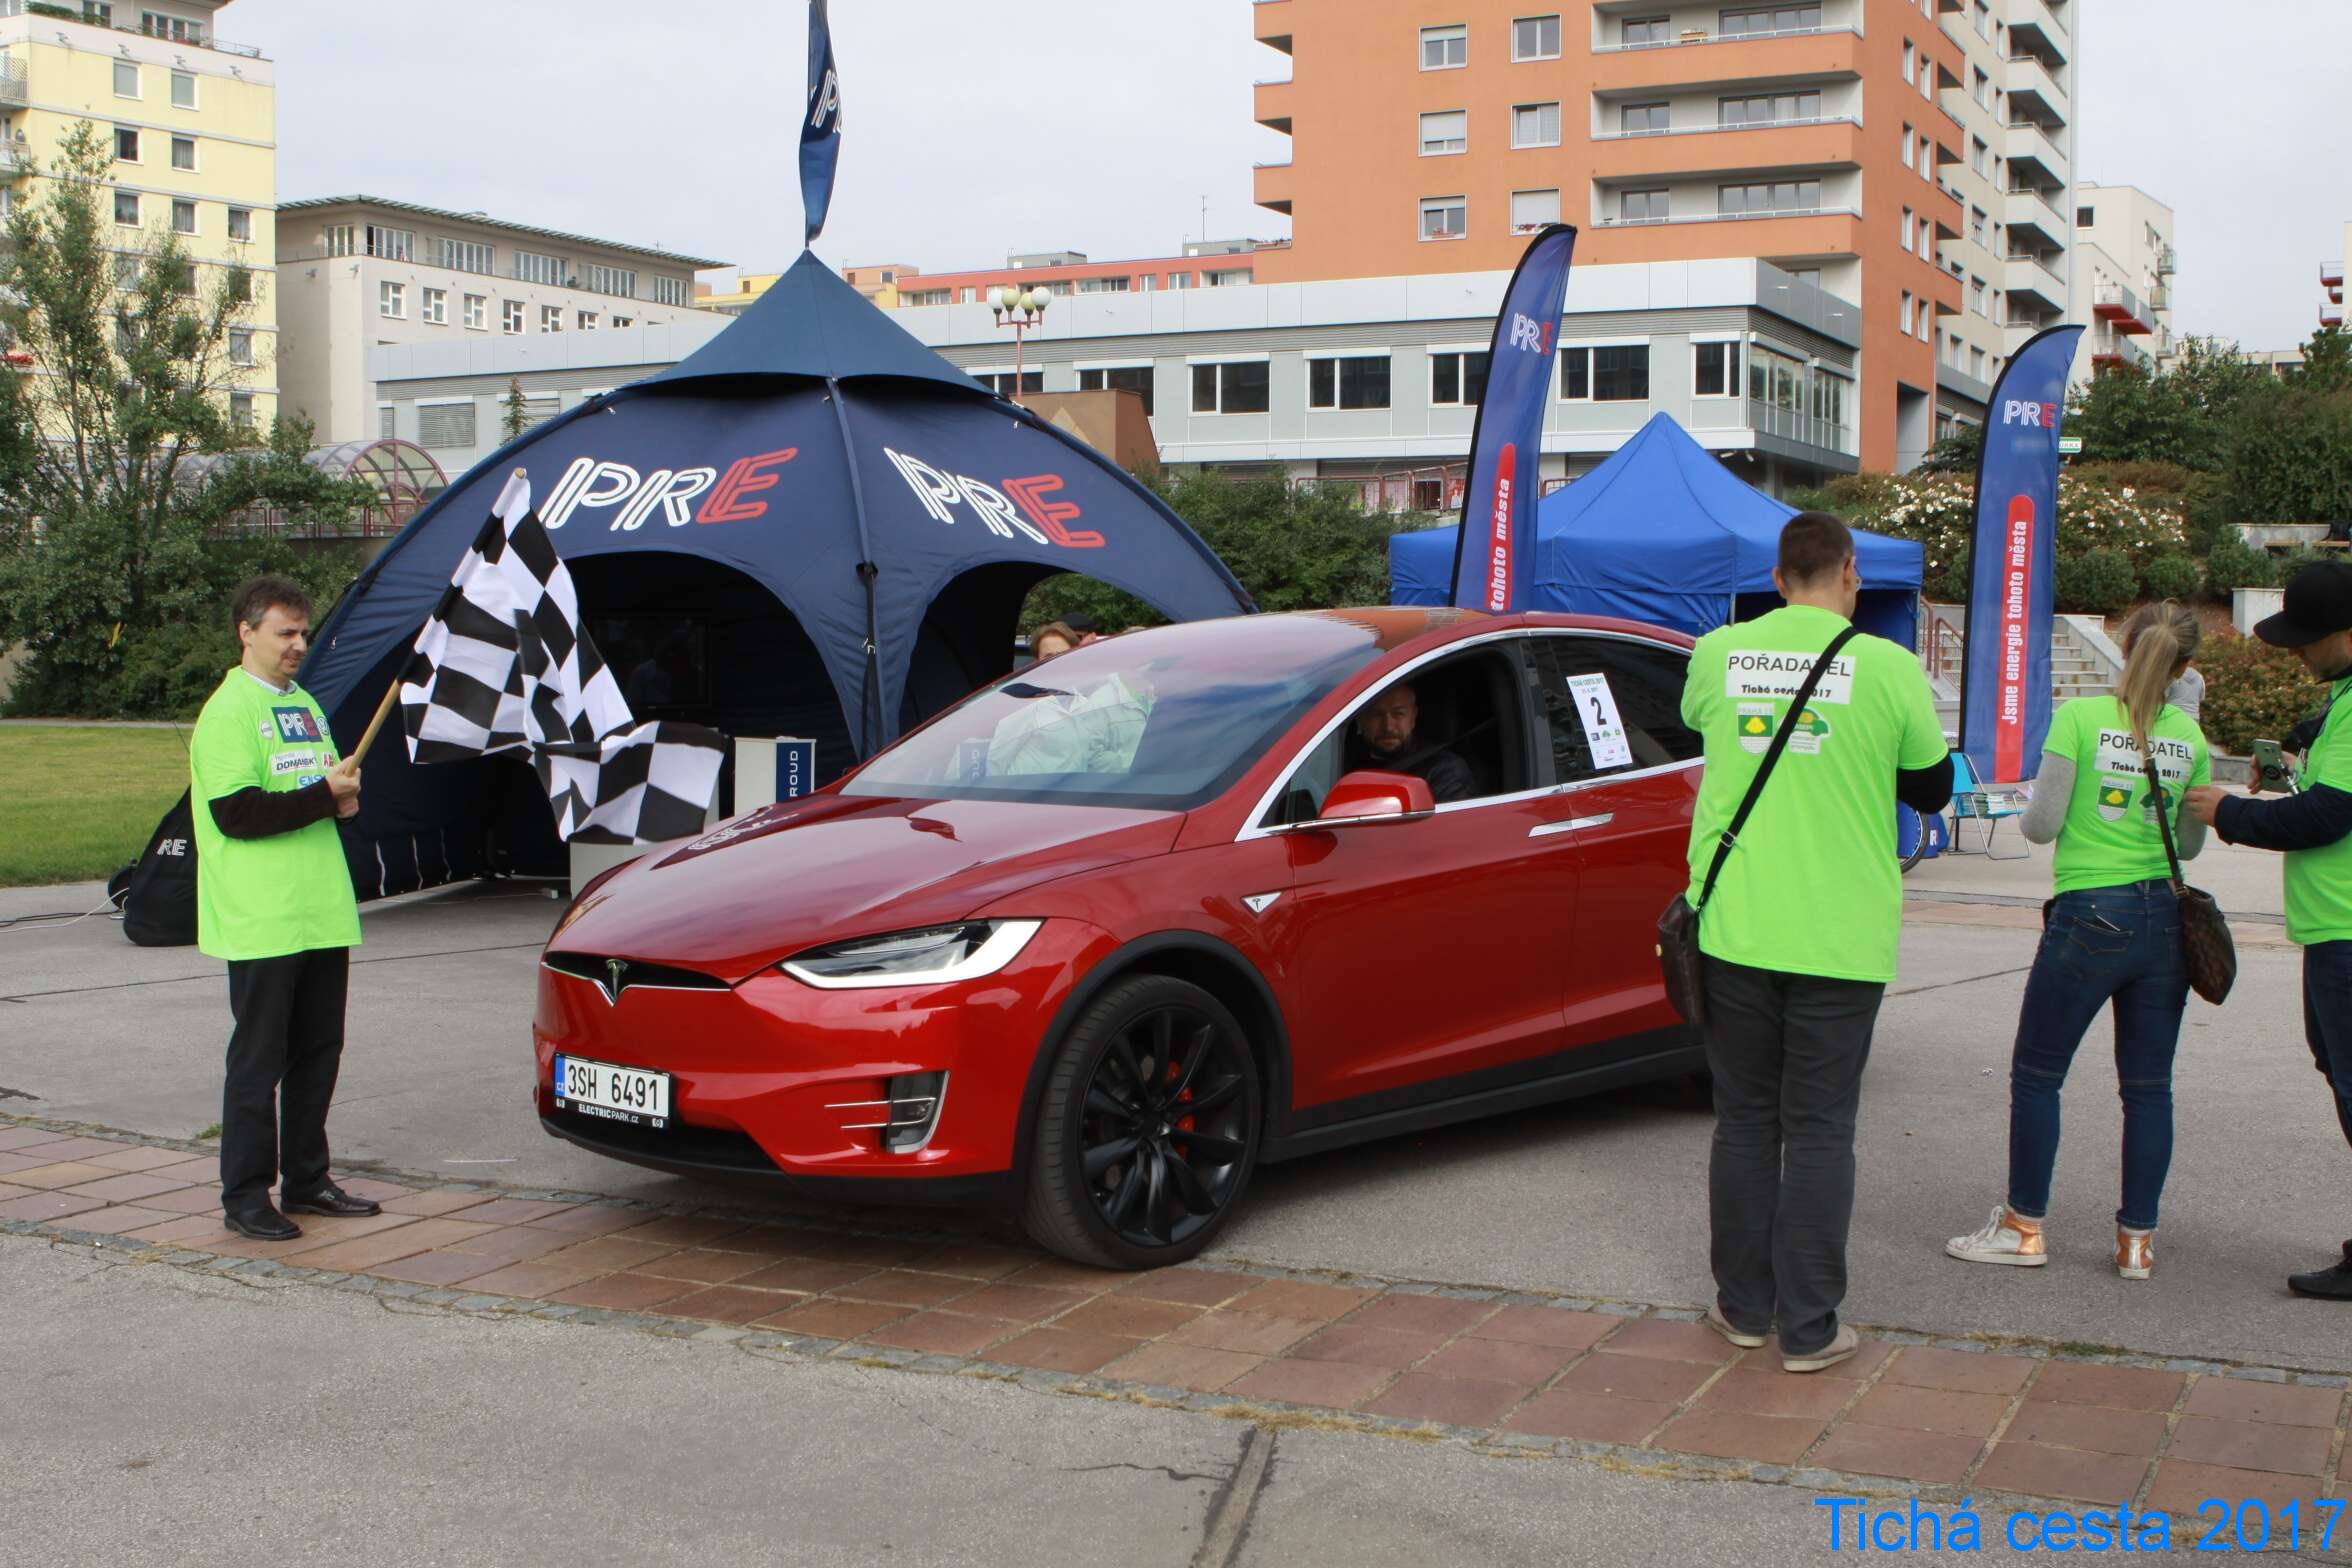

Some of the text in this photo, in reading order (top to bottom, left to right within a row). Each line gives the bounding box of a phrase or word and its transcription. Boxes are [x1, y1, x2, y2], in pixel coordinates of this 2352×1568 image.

[1510, 312, 1552, 357] PRE
[2003, 400, 2058, 429] PRE
[538, 447, 798, 531] PRE
[884, 447, 1105, 547] PRE
[1490, 478, 1510, 611] tohoto města
[2002, 521, 2027, 724] Jsme energie tohoto města
[1728, 654, 1851, 677] POŘADAEL
[1590, 697, 1607, 725] 2
[1812, 687, 1832, 698] 017
[277, 712, 318, 736] PRE
[568, 1064, 658, 1111] 3SH 6491
[578, 1103, 640, 1124] ELECTRICPARK.CZ
